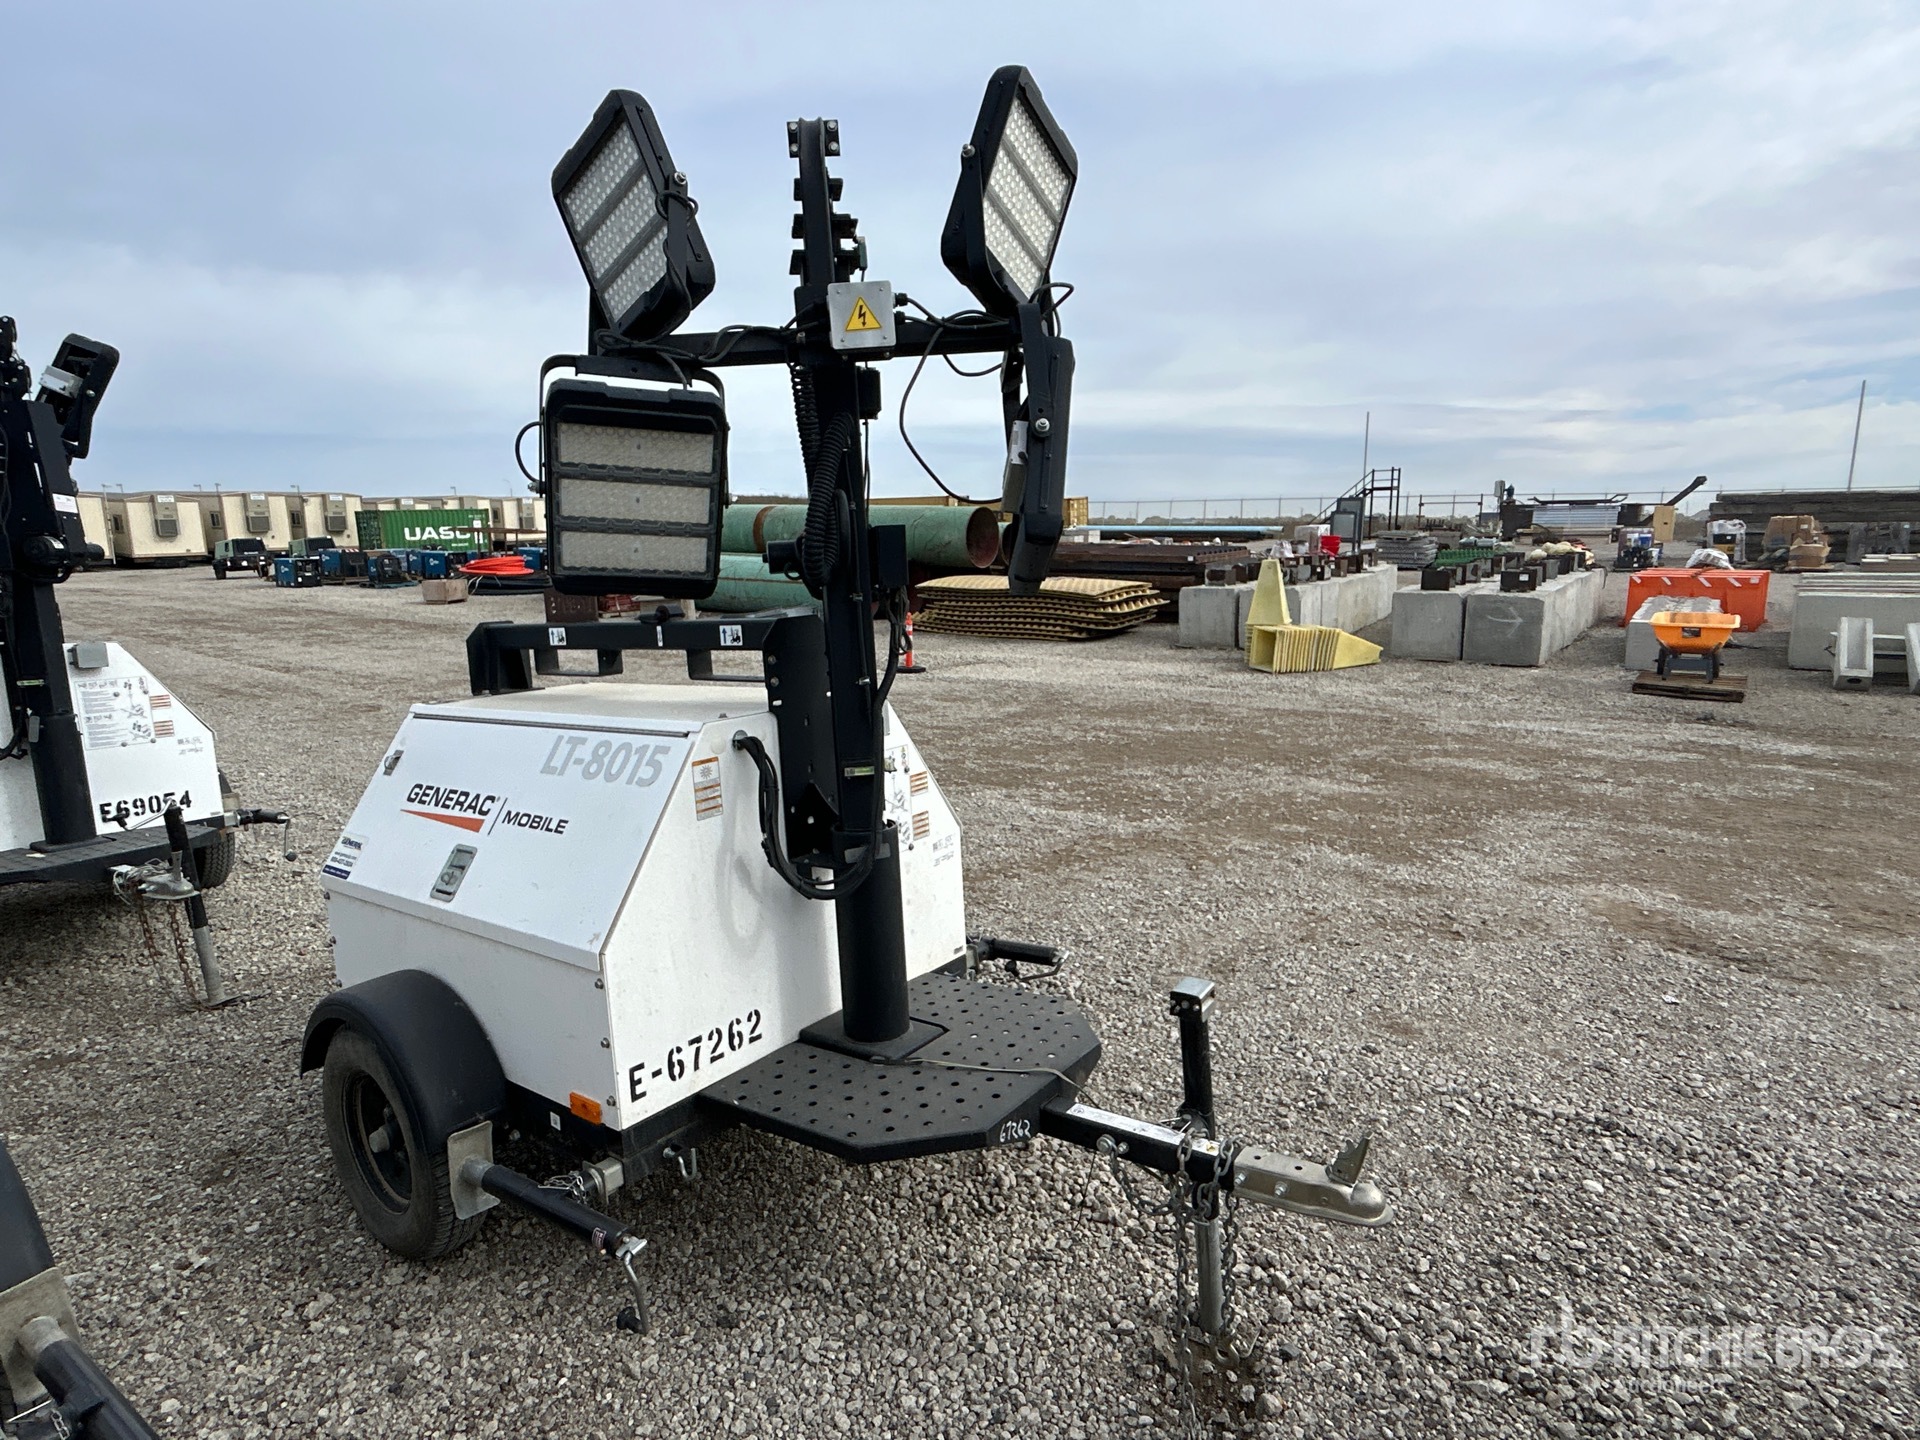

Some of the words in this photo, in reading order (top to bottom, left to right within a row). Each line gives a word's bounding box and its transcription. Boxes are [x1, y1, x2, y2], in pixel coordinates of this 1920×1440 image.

[404, 526, 471, 541] UASC
[540, 735, 671, 787] LT-8015
[406, 783, 496, 816] GENERAC
[502, 810, 569, 835] MOBILE
[629, 1009, 762, 1103] E-67262
[1000, 1119, 1032, 1143] 67262
